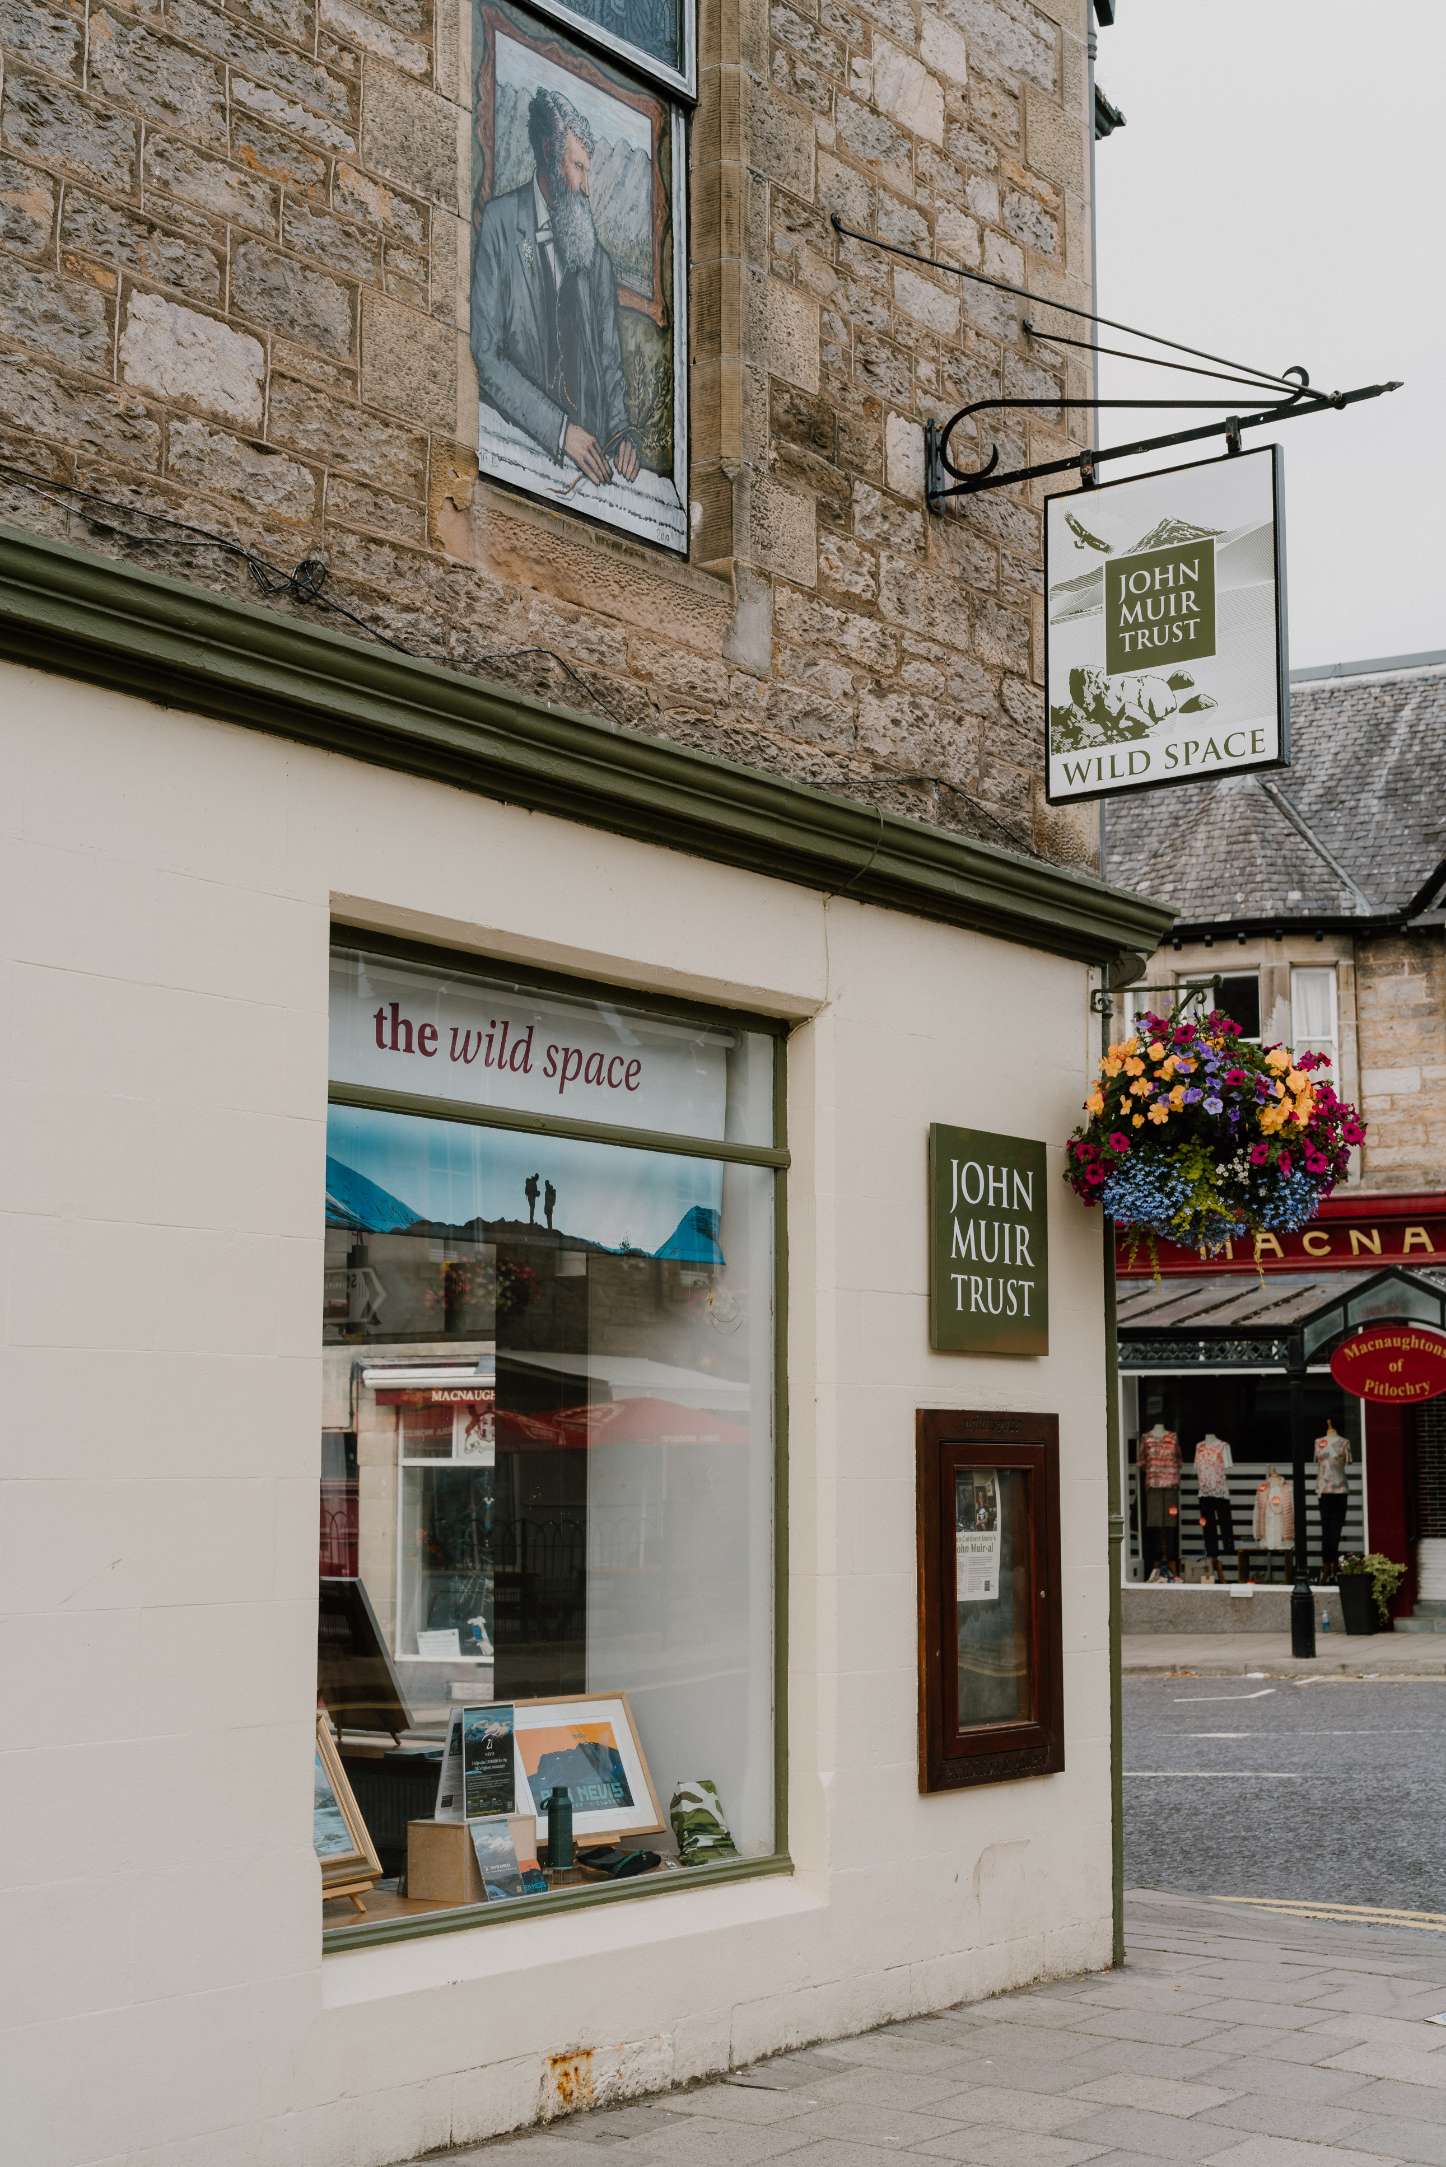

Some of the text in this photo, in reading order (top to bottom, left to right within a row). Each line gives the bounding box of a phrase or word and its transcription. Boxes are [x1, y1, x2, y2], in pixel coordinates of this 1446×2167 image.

[1118, 558, 1201, 605] JOHN
[1118, 588, 1201, 628] MUIR
[1118, 618, 1201, 653] TRUST
[1061, 727, 1267, 788] WILD SPACE
[373, 1001, 643, 1095] the wild space
[949, 1158, 1034, 1214] JOHN
[949, 1216, 1036, 1268] MUIR
[949, 1273, 1035, 1318] TRUST
[1364, 1378, 1431, 1396] Pitlochry
[1388, 1358, 1405, 1373] of
